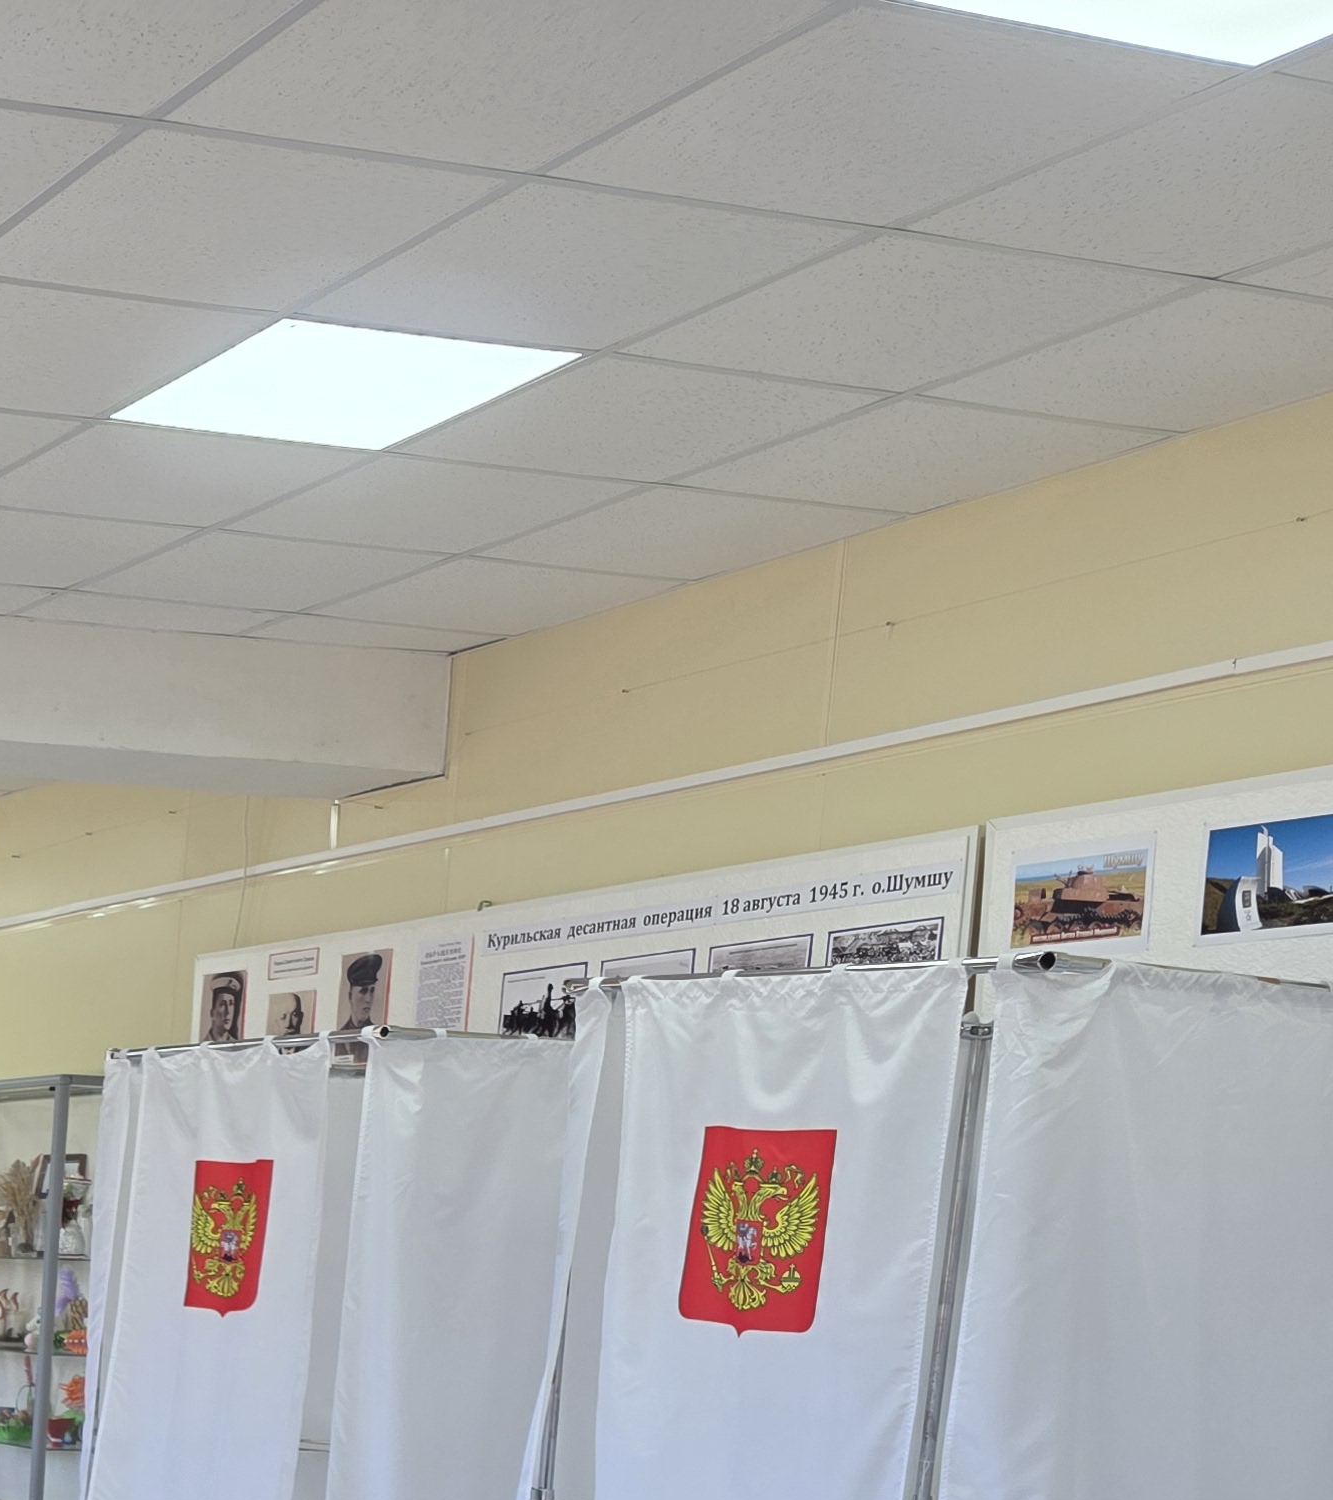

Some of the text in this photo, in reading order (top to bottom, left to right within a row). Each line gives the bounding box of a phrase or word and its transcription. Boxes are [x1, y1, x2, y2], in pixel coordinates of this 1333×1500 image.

[1103, 853, 1144, 869] Шумшу
[487, 870, 953, 950] Курильская десантная операция 18 августа 1945 г. о.Шумшу
